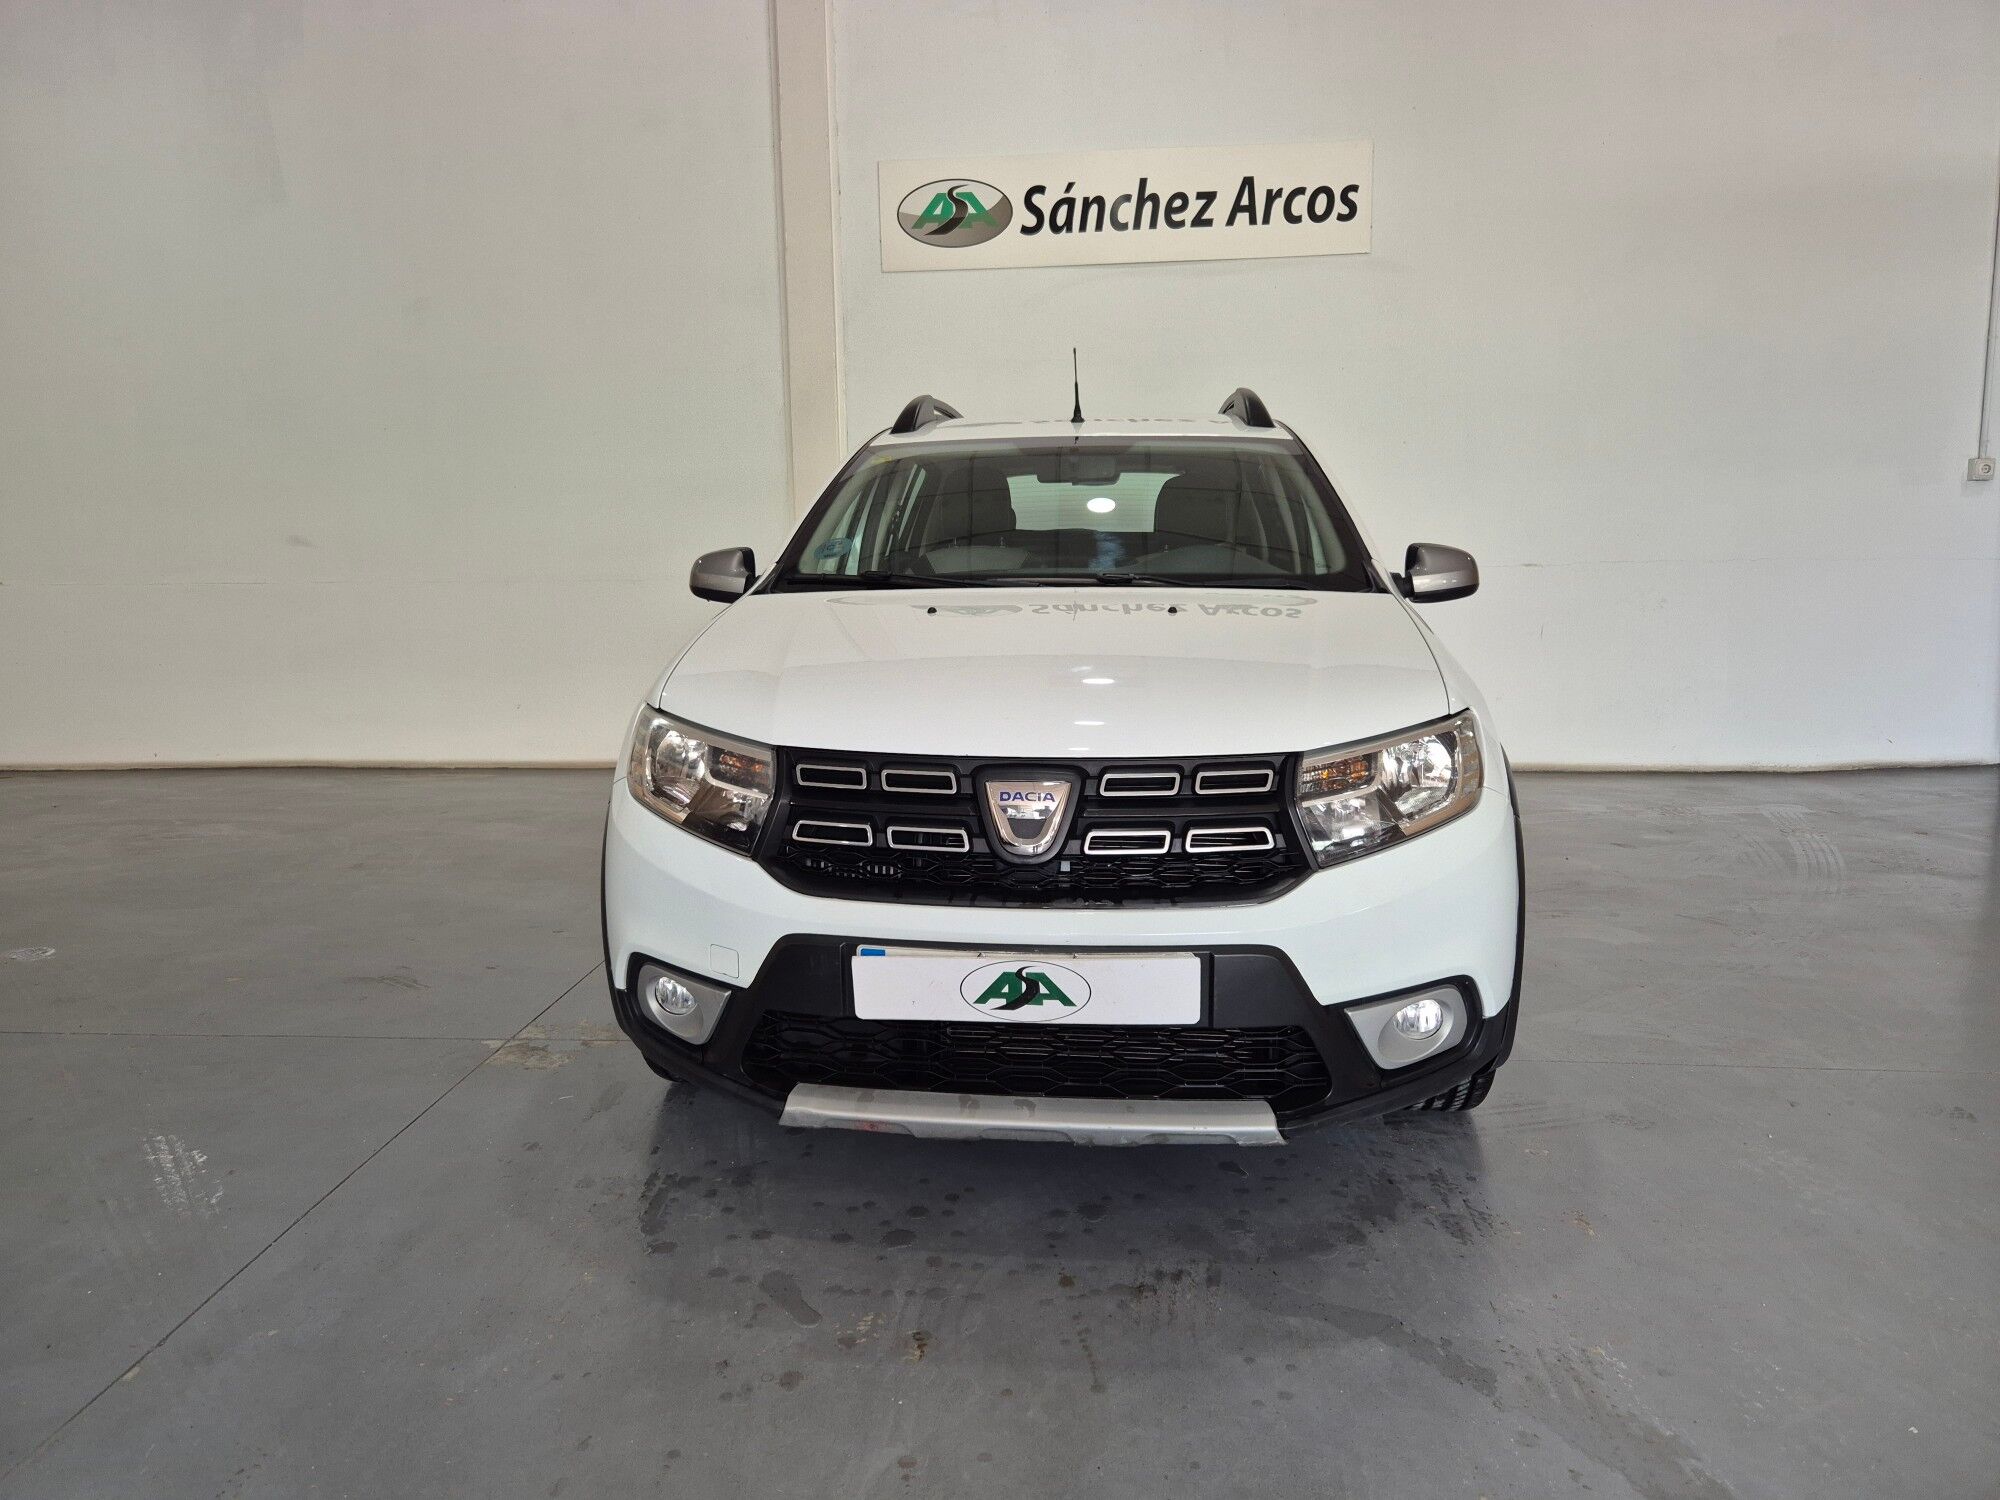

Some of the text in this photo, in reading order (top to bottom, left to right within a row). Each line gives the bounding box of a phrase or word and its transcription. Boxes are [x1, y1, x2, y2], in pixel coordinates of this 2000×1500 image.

[1020, 177, 1216, 236] Sánchez
[1226, 175, 1361, 228] Arcos
[999, 791, 1056, 802] DACIA
